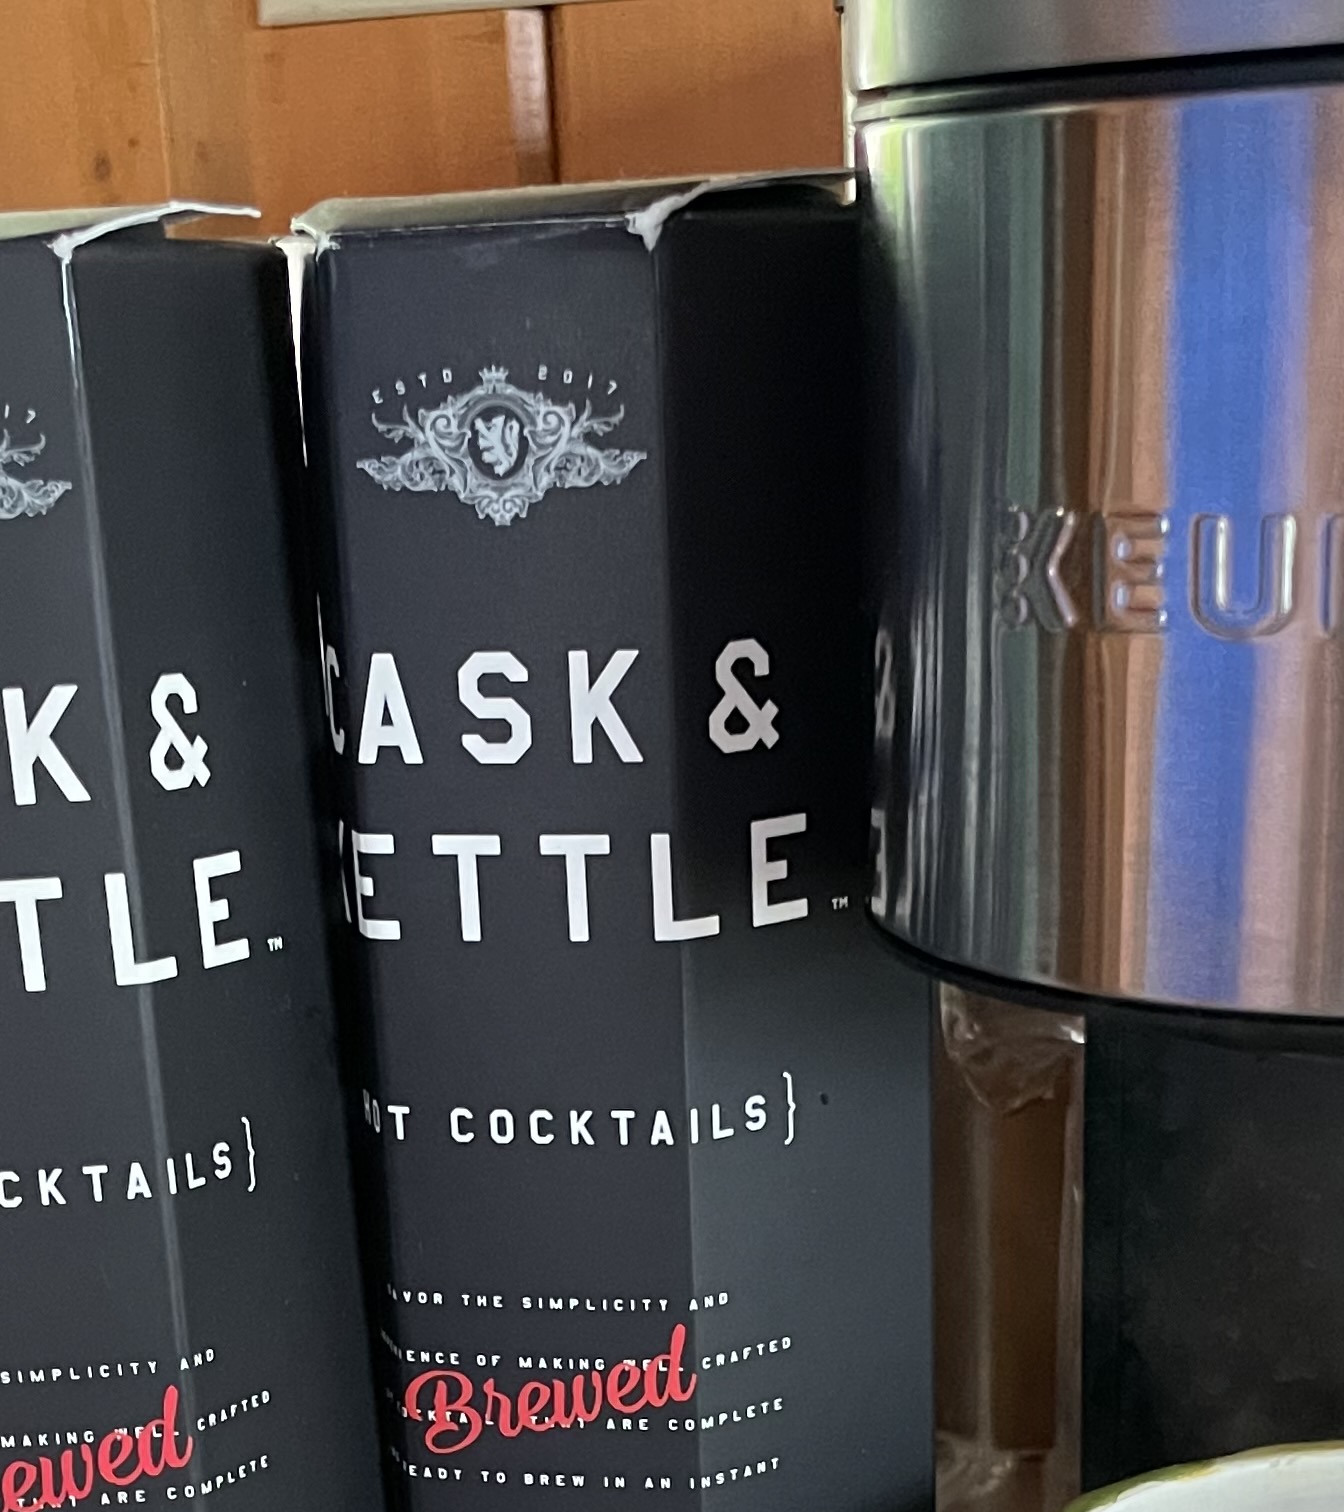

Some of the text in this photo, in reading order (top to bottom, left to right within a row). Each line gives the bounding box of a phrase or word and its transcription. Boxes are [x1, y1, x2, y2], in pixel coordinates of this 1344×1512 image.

[537, 364, 618, 395] 2017
[708, 638, 780, 754] &
[149, 672, 212, 791] &
[339, 812, 809, 942] ETTLE
[522, 1292, 729, 1312] SIMPLICITY AND
[0, 1361, 157, 1385] SIMPLICITY
[179, 1348, 215, 1371] AND
[518, 1356, 606, 1371] MAKING
[701, 1336, 792, 1370] CRAFTED
[404, 1322, 697, 1455] Brewed
[0, 1430, 95, 1449] MAKING
[197, 1390, 271, 1432] CRAFTED
[668, 1397, 783, 1431] COMPLETE
[100, 1489, 146, 1506] ARE
[166, 1454, 269, 1501] COMPLETE
[524, 1457, 780, 1489] BREW INSTANT
